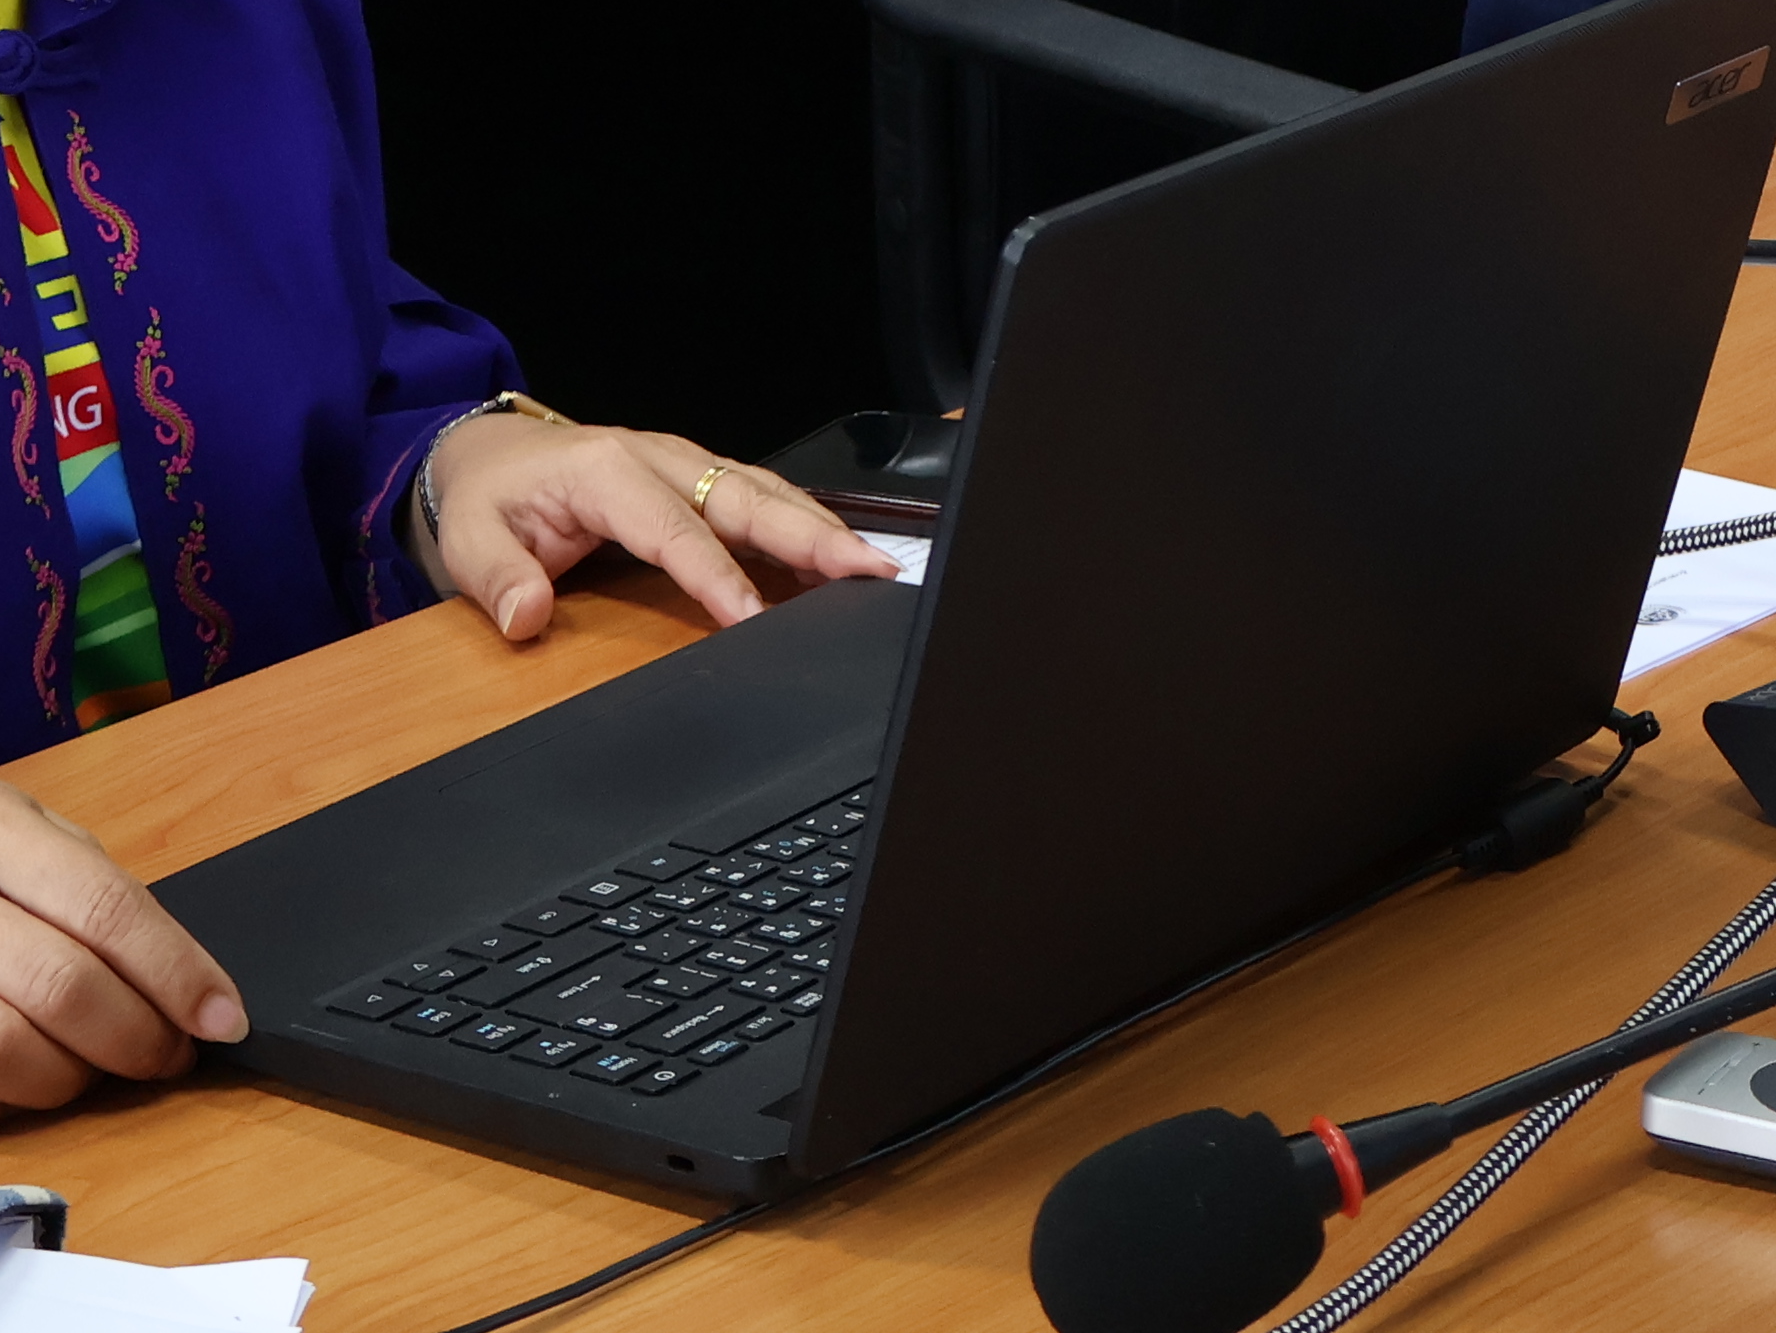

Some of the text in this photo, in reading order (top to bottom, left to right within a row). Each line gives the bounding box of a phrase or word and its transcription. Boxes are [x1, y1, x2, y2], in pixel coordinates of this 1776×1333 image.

[1687, 60, 1752, 109] acer
[557, 984, 589, 1000] Enter
[662, 1015, 710, 1039] Backspace
